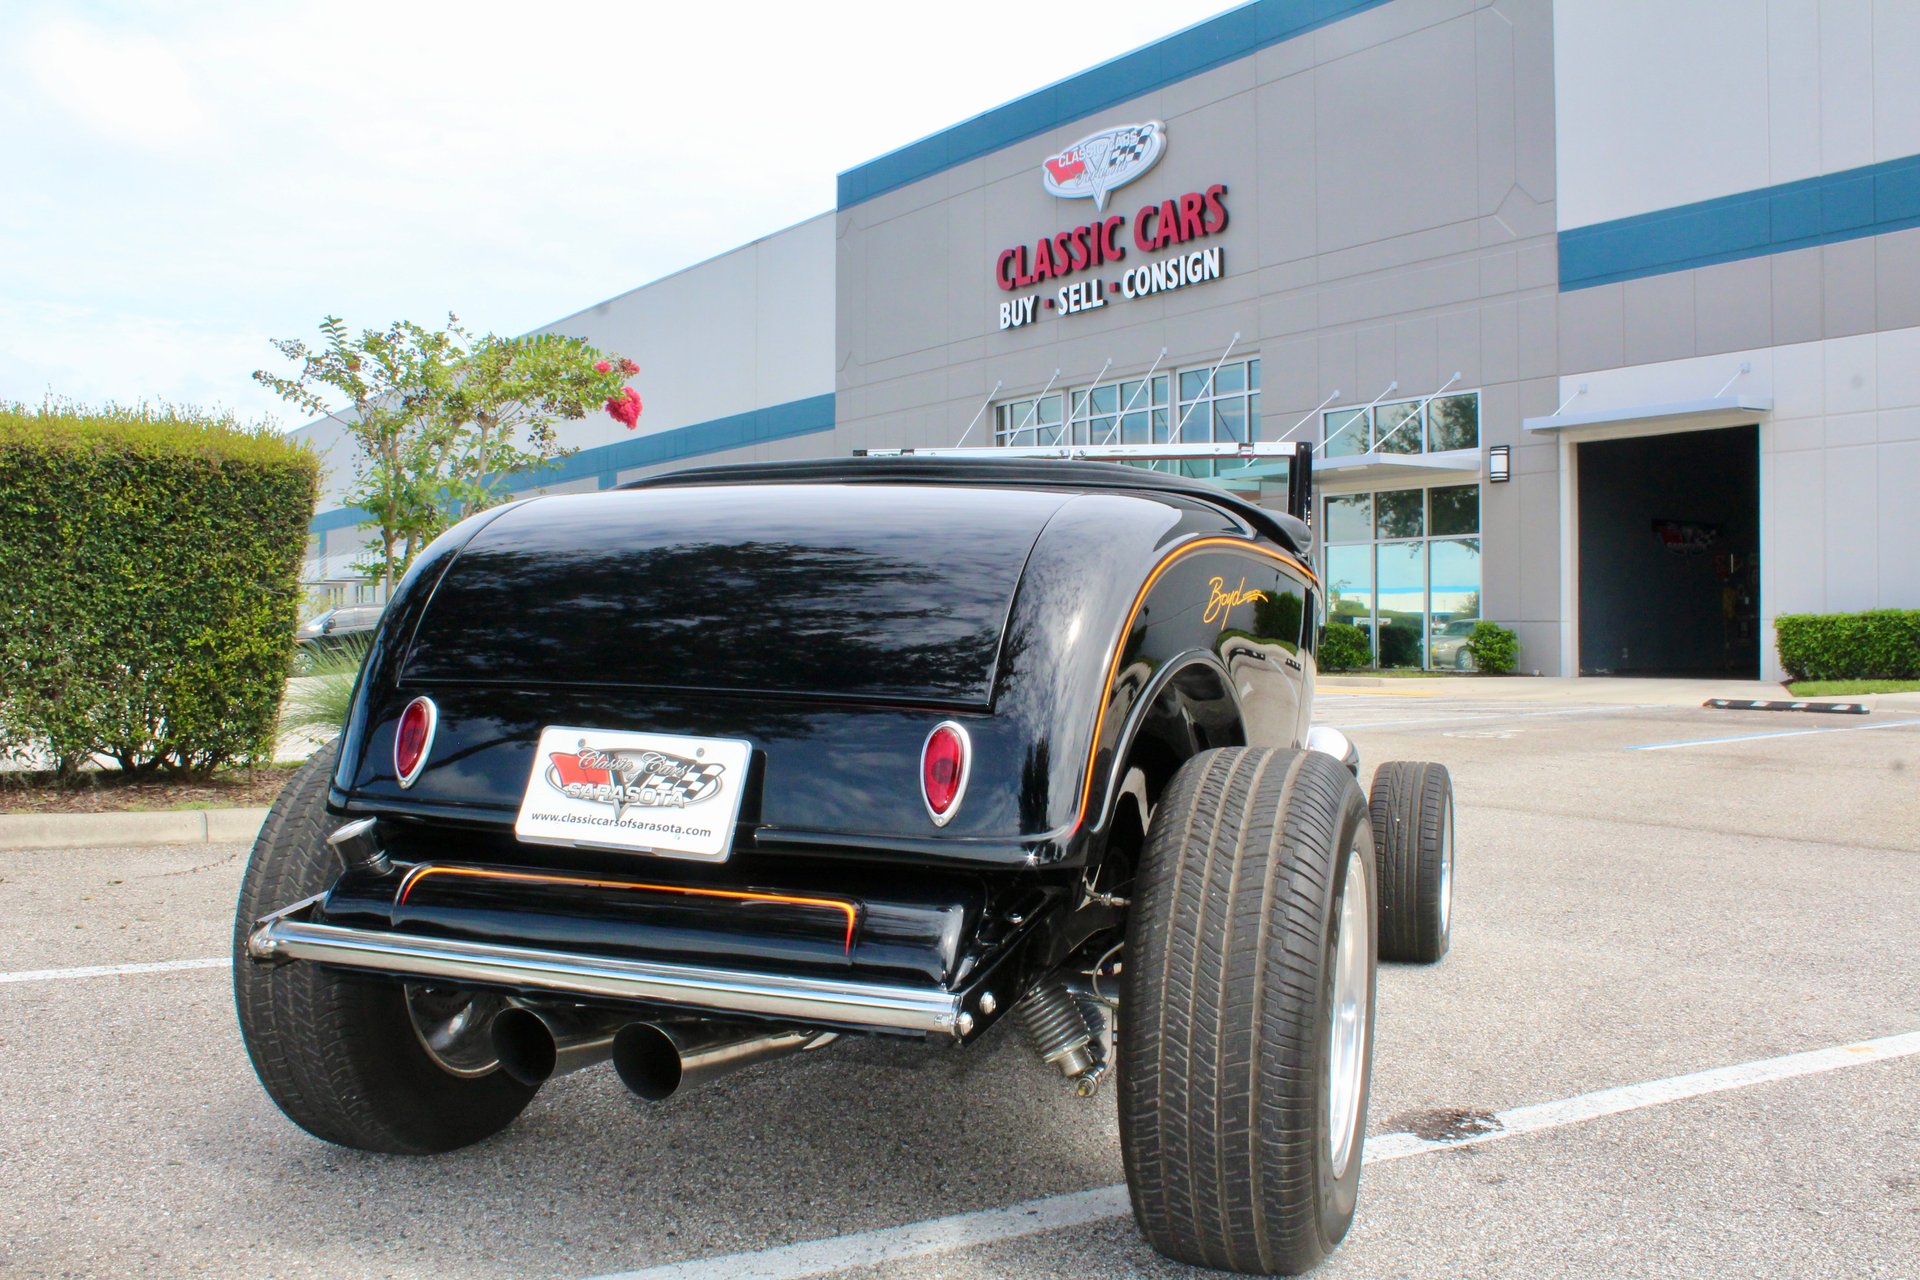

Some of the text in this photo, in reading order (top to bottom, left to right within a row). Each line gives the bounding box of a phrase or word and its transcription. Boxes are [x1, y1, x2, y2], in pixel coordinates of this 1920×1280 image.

[1058, 130, 1138, 168] CLASSIC CARS
[996, 184, 1227, 291] CLASSIC CARS
[1000, 247, 1220, 330] BUY SELL CONSIGN
[577, 747, 689, 778] Classic Cars
[566, 781, 686, 809] SARASOTA
[531, 811, 712, 838] www.classiccarsofsarasota.com
